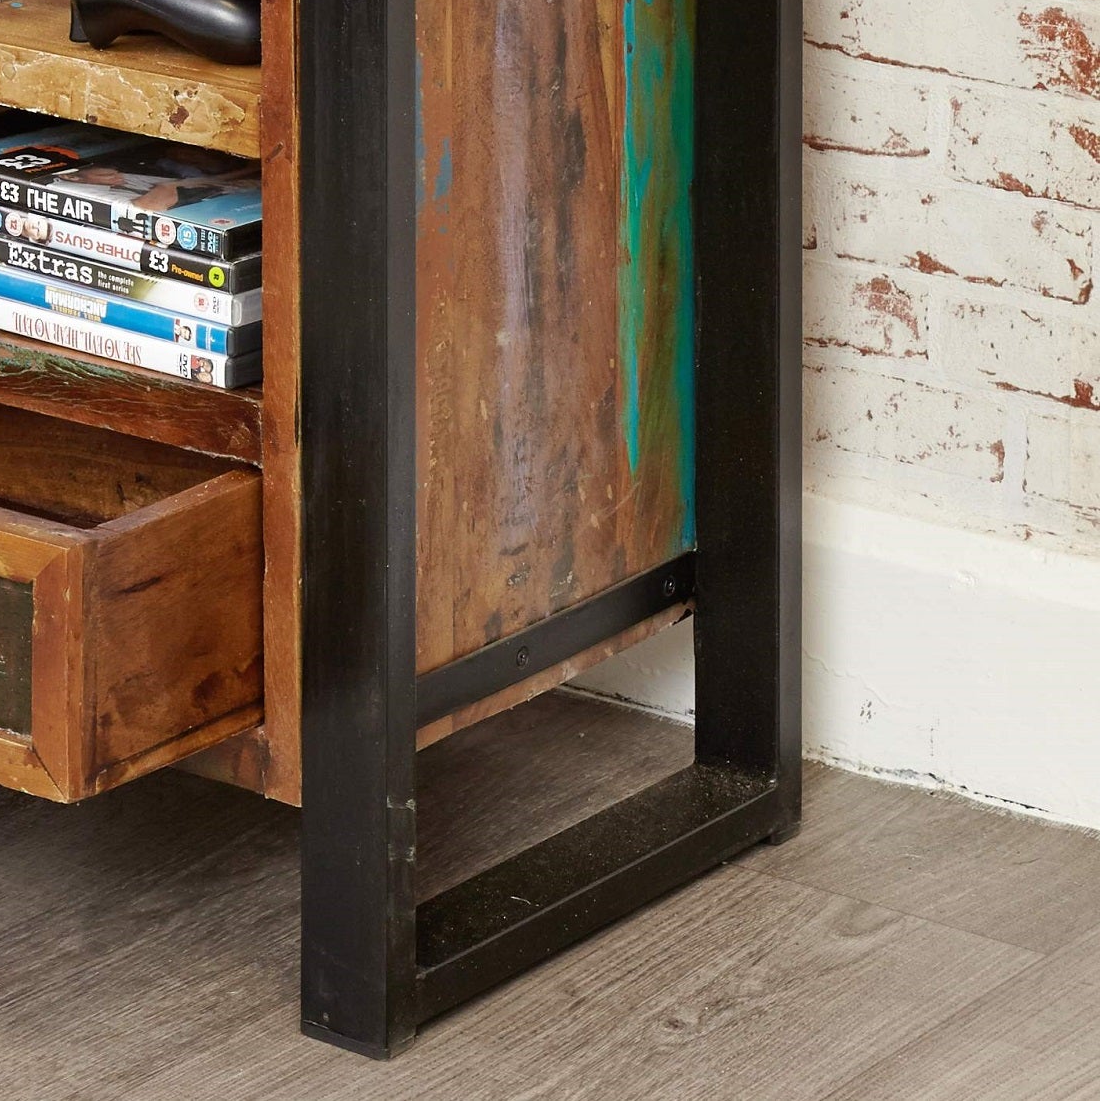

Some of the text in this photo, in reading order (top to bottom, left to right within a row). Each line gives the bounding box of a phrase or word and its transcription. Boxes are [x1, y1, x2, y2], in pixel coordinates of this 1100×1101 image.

[0, 181, 19, 203] £3
[27, 187, 93, 223] THE AIR
[10, 219, 18, 230] 12
[161, 223, 170, 237] 15
[183, 230, 192, 242] 15
[56, 231, 141, 263] OTHER GUYS
[7, 242, 93, 285] Extras
[149, 250, 204, 282] £3 Pre-owned
[97, 280, 130, 294] first series
[98, 270, 134, 287] the complete
[35, 318, 49, 338] NO
[54, 324, 78, 345] HEAR
[104, 338, 121, 358] NO
[124, 341, 142, 364] SEE
